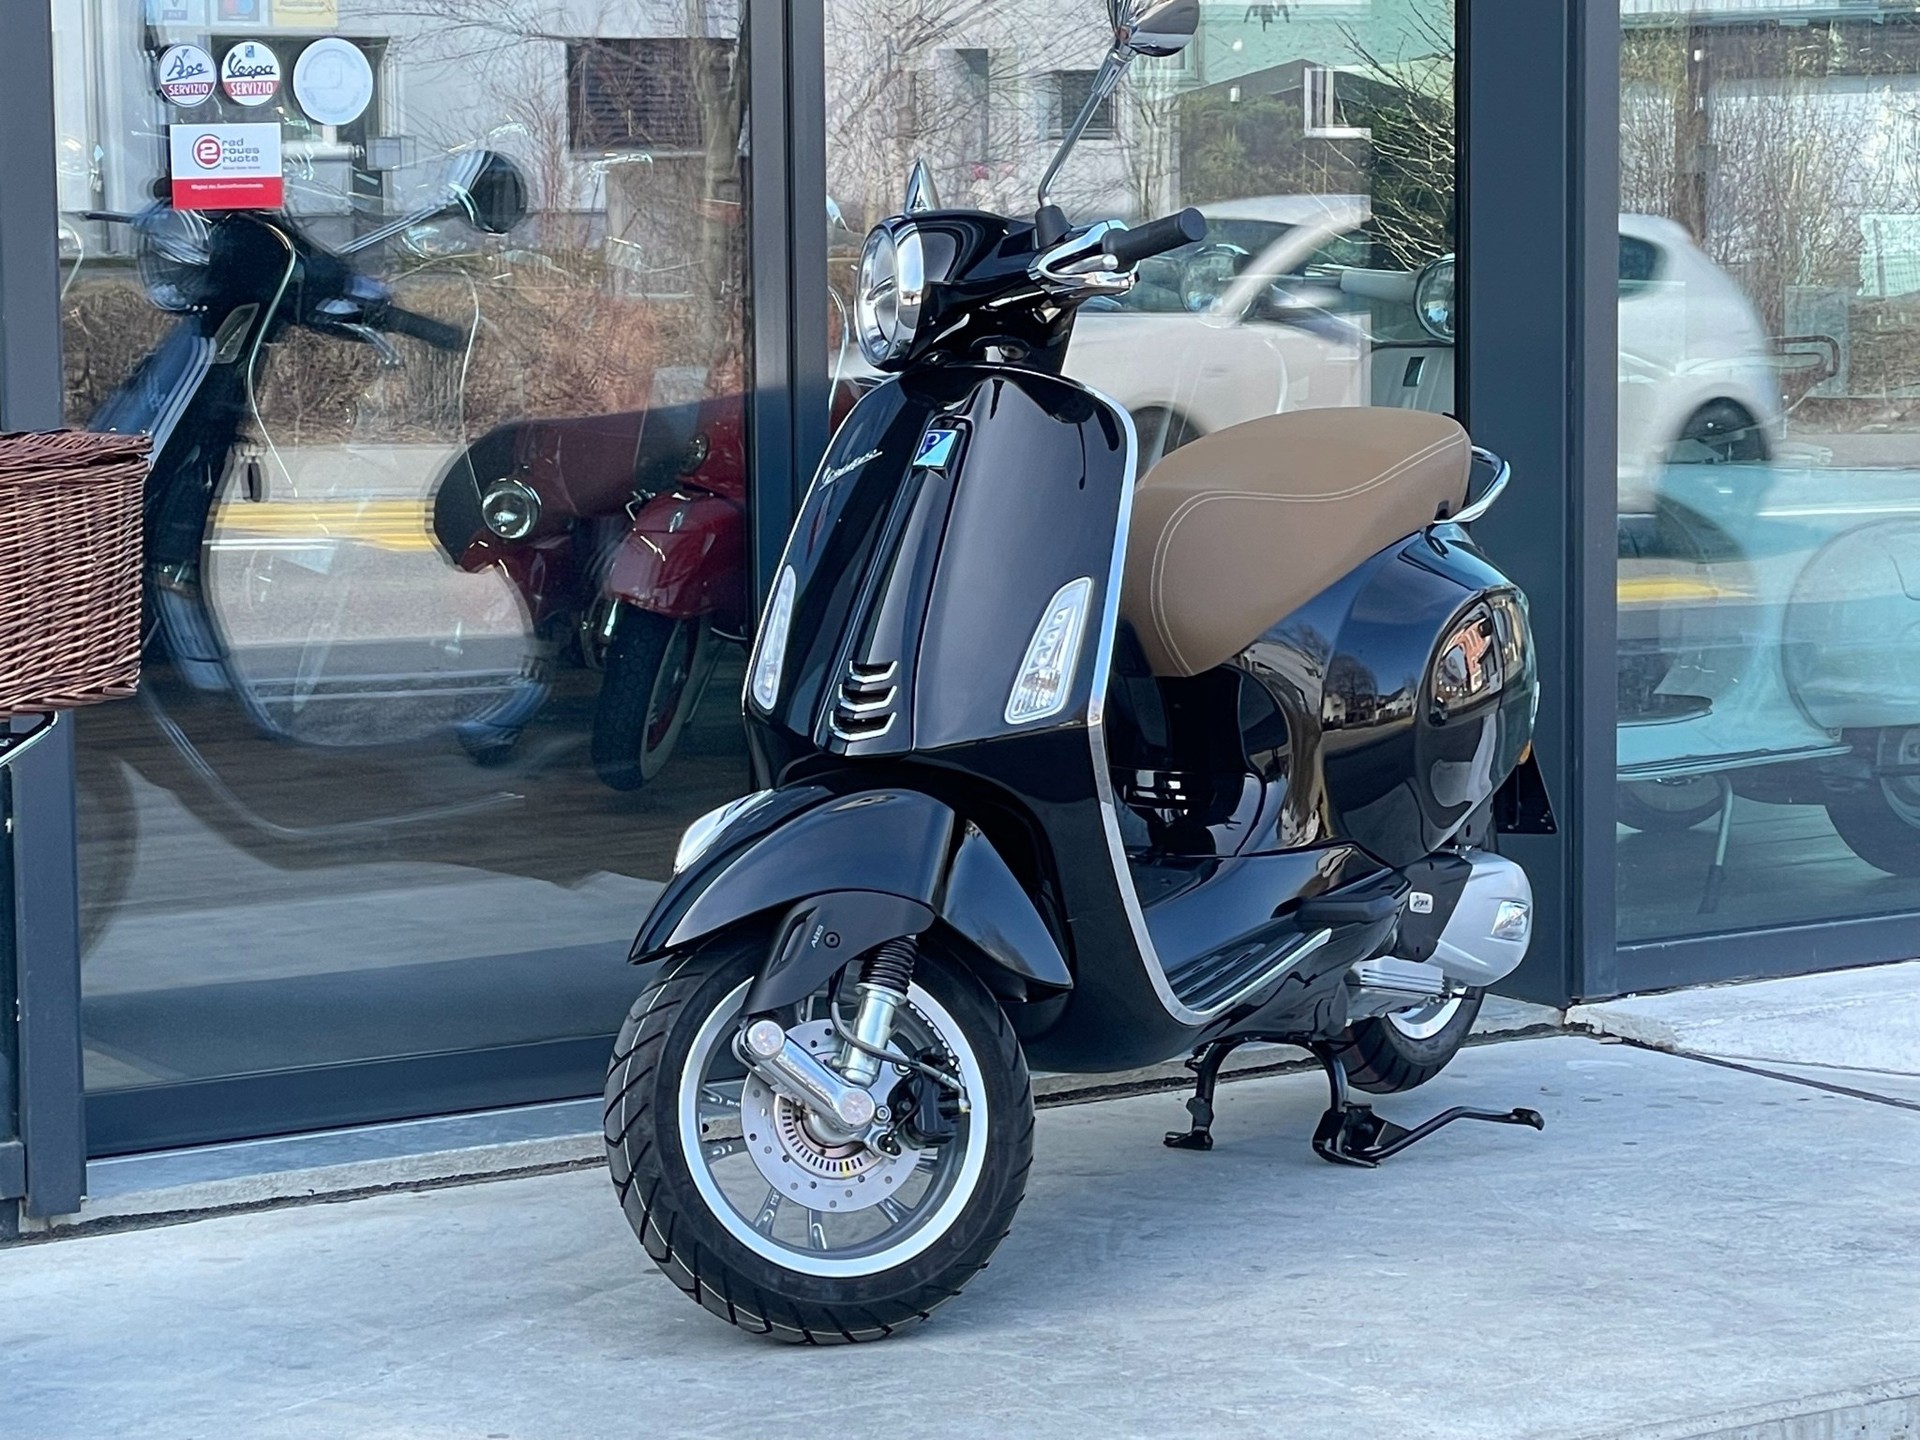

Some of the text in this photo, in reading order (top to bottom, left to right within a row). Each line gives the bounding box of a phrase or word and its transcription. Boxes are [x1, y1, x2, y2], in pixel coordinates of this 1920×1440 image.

[227, 52, 276, 79] Vespa
[168, 83, 209, 96] SERVIZIO
[230, 81, 274, 96] SERVIZIO
[222, 138, 244, 147] rad
[222, 147, 260, 155] roues
[222, 155, 259, 163] ruote
